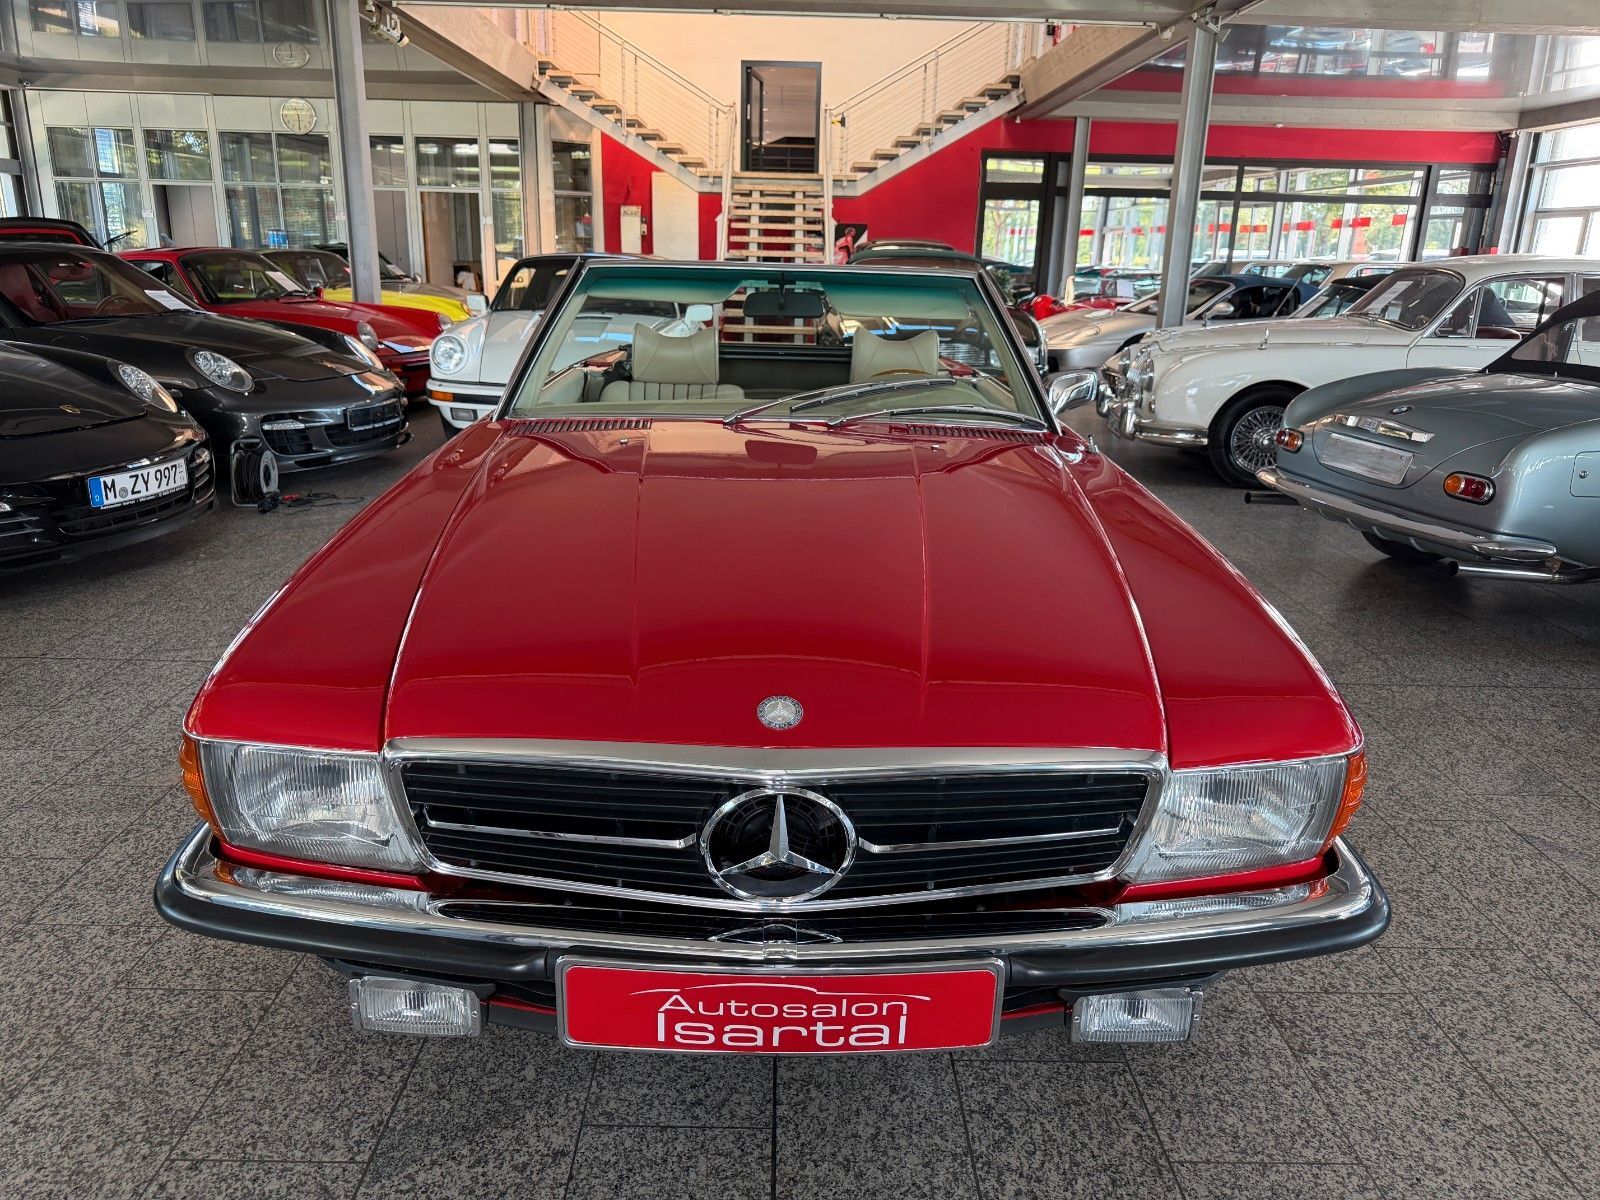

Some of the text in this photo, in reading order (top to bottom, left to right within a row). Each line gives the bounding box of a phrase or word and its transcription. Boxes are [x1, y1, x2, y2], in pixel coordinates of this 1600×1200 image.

[103, 479, 117, 499] M
[129, 472, 150, 495] ZY
[155, 465, 177, 489] 997
[658, 995, 908, 1018] Autosalon
[657, 1012, 906, 1047] Isartal
